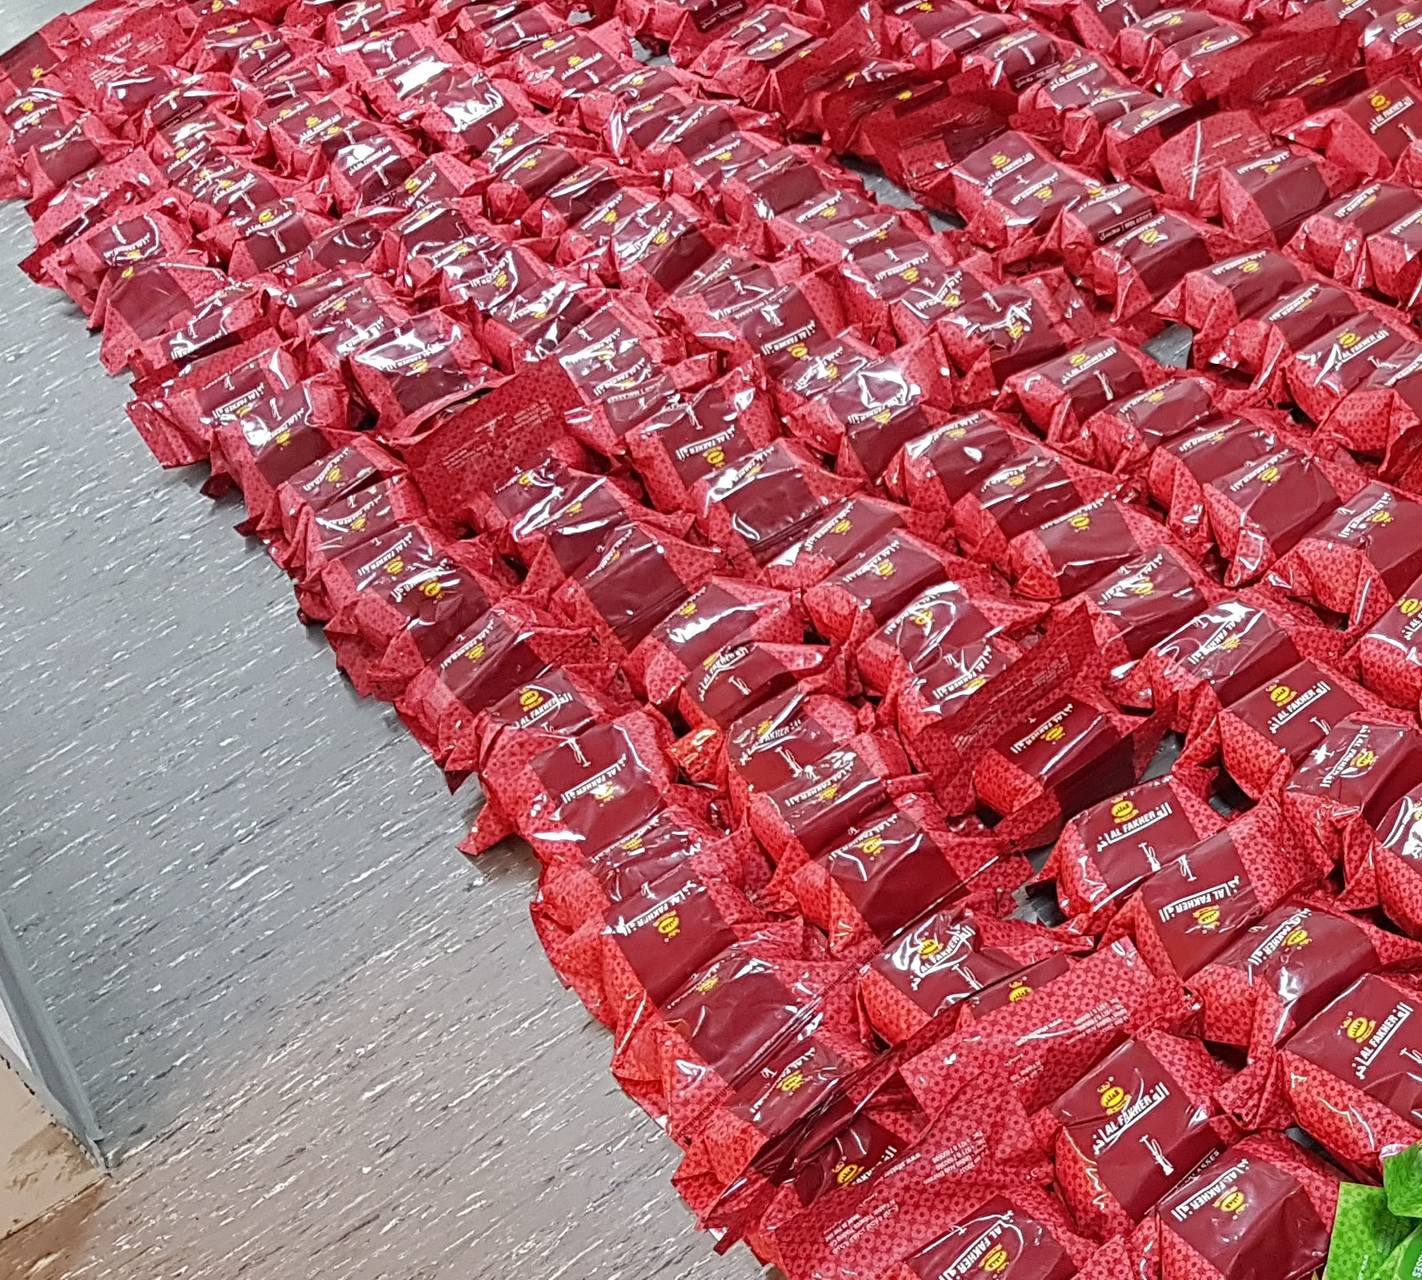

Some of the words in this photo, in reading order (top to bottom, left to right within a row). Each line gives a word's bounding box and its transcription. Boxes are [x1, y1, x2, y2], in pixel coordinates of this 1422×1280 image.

[1225, 620, 1236, 630] AL
[1410, 619, 1421, 628] AL
[973, 661, 985, 672] AL
[1277, 710, 1289, 720] AL
[1287, 689, 1317, 712] FAKHER
[521, 716, 532, 727] AL
[1353, 738, 1364, 747] AL
[605, 767, 616, 777] AL
[574, 773, 606, 795] FAKHER
[1111, 828, 1122, 841] AL
[1123, 811, 1156, 833] FAKHER
[668, 894, 680, 905] AL
[1212, 889, 1224, 900] AL
[1174, 893, 1211, 913] FAKHER
[919, 963, 932, 974] AL
[928, 934, 963, 967] FAKHER
[1360, 1047, 1376, 1060] AL
[1369, 1015, 1401, 1047] FAKHER
[1105, 1121, 1119, 1136] AL
[1117, 1095, 1155, 1126] FAKHER
[1221, 1168, 1237, 1182] AL
[1188, 1180, 1226, 1209] FAKHER
[989, 1224, 1002, 1239] AL
[956, 1235, 991, 1274] FAKHER
